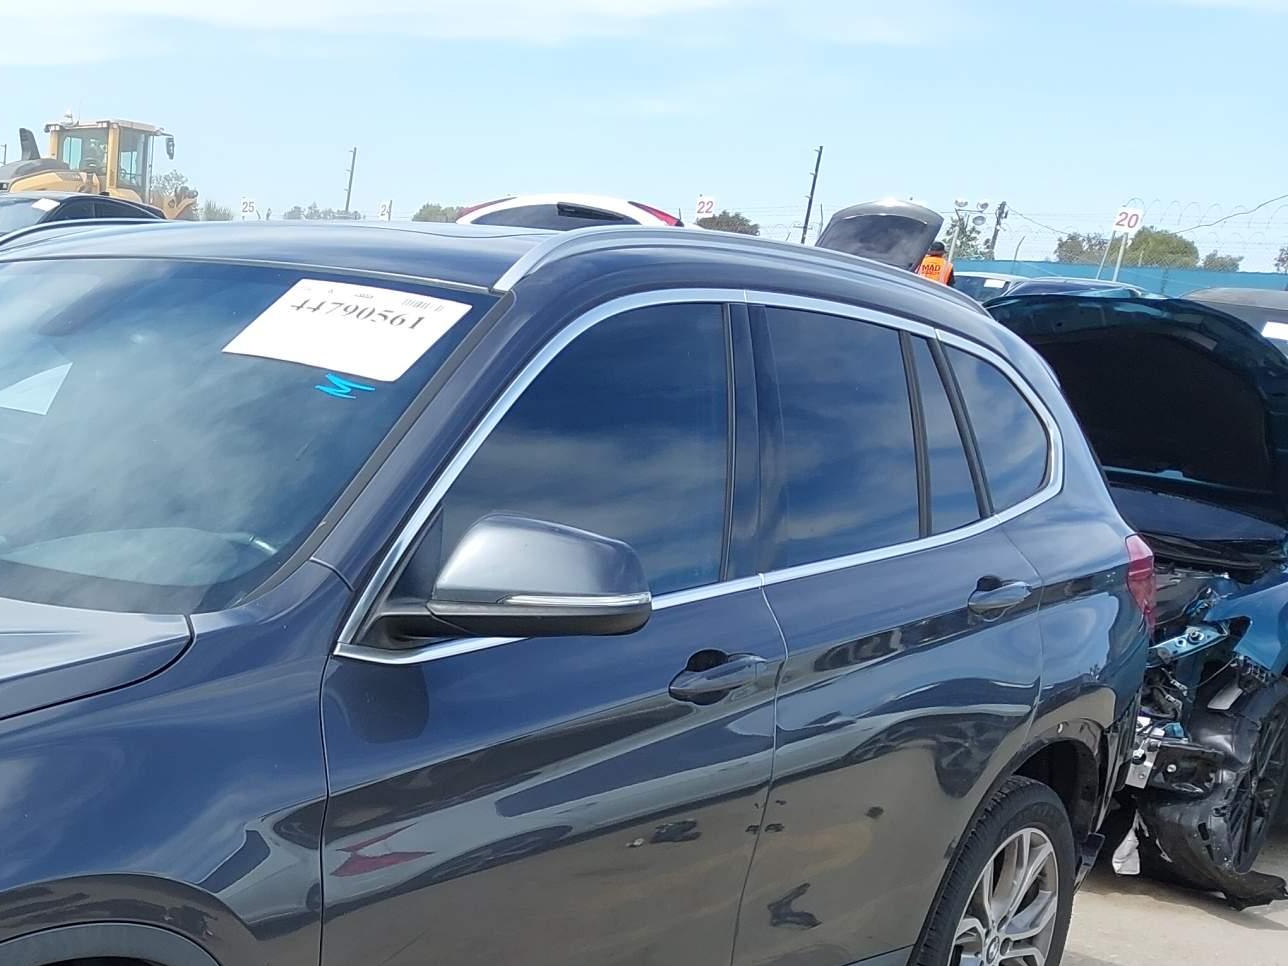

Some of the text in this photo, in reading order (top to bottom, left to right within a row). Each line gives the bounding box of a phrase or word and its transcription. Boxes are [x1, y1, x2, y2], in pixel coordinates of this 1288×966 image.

[242, 201, 255, 213] 25
[697, 200, 714, 214] 22
[1115, 211, 1140, 229] 20
[922, 264, 941, 272] MAD
[290, 299, 425, 330] 44790561
